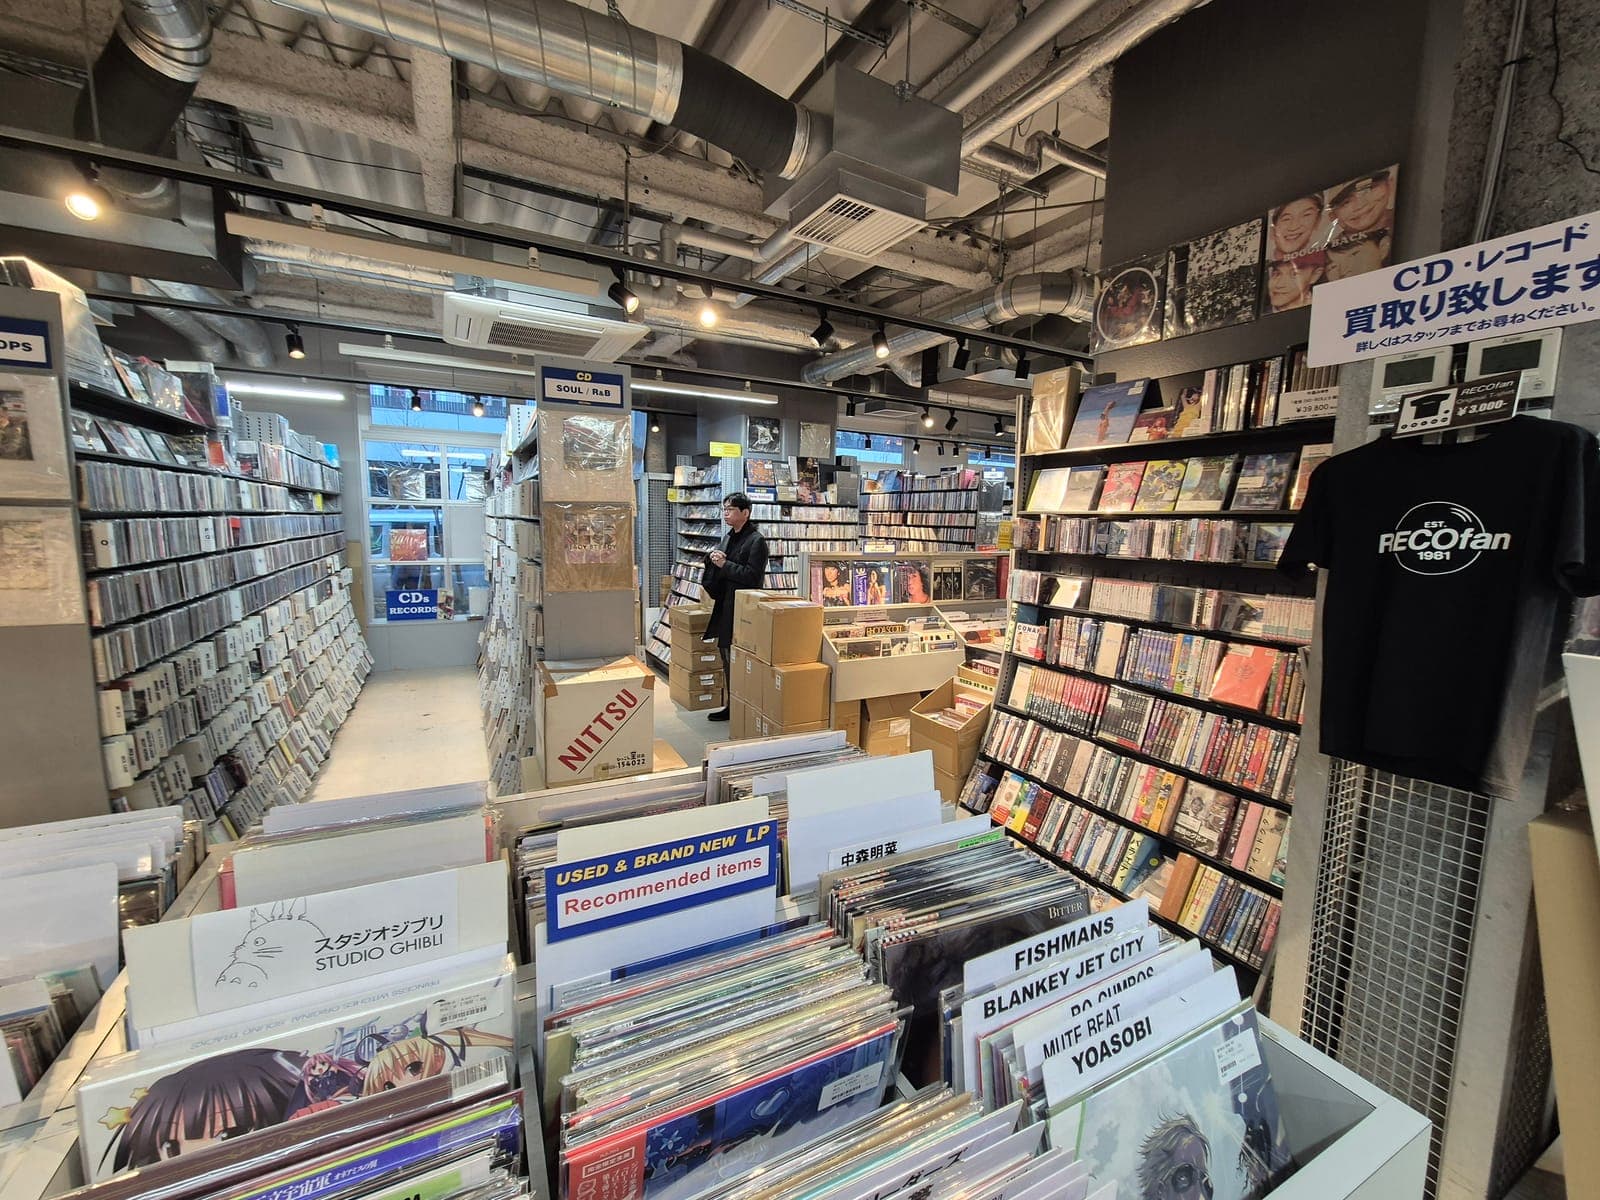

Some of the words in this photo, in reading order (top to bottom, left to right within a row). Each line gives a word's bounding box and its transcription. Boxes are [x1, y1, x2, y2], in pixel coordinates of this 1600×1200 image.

[1331, 231, 1369, 248] BACK
[1355, 301, 1595, 353] 詳しくはスタッフまでお尋ねください。
[556, 384, 583, 394] SOUL
[592, 388, 611, 397] R&B
[576, 371, 593, 382] CD
[1461, 380, 1514, 396] RECOfan
[1378, 528, 1512, 553] RECOfan
[1417, 551, 1451, 560] 1981
[389, 606, 437, 615] RECORDS
[398, 592, 430, 604] CDs
[558, 688, 638, 771] NITTSU
[556, 863, 609, 886] USED
[615, 859, 628, 873] &
[634, 845, 695, 869] BRAND
[700, 834, 737, 854] NEW
[745, 825, 770, 843] LP
[841, 841, 898, 867] 中森明菜
[565, 866, 711, 916] Recommended
[717, 857, 762, 877] items
[314, 914, 443, 954] スタジオジブリ
[1015, 917, 1114, 971] FISHMANS
[316, 947, 385, 971] STUDIO
[390, 933, 443, 955] GHIBLI
[983, 967, 1070, 1019] BLANKEY
[1075, 953, 1105, 979] JET
[1110, 936, 1144, 964] CITY
[1072, 1016, 1152, 1075] YOASOBI
